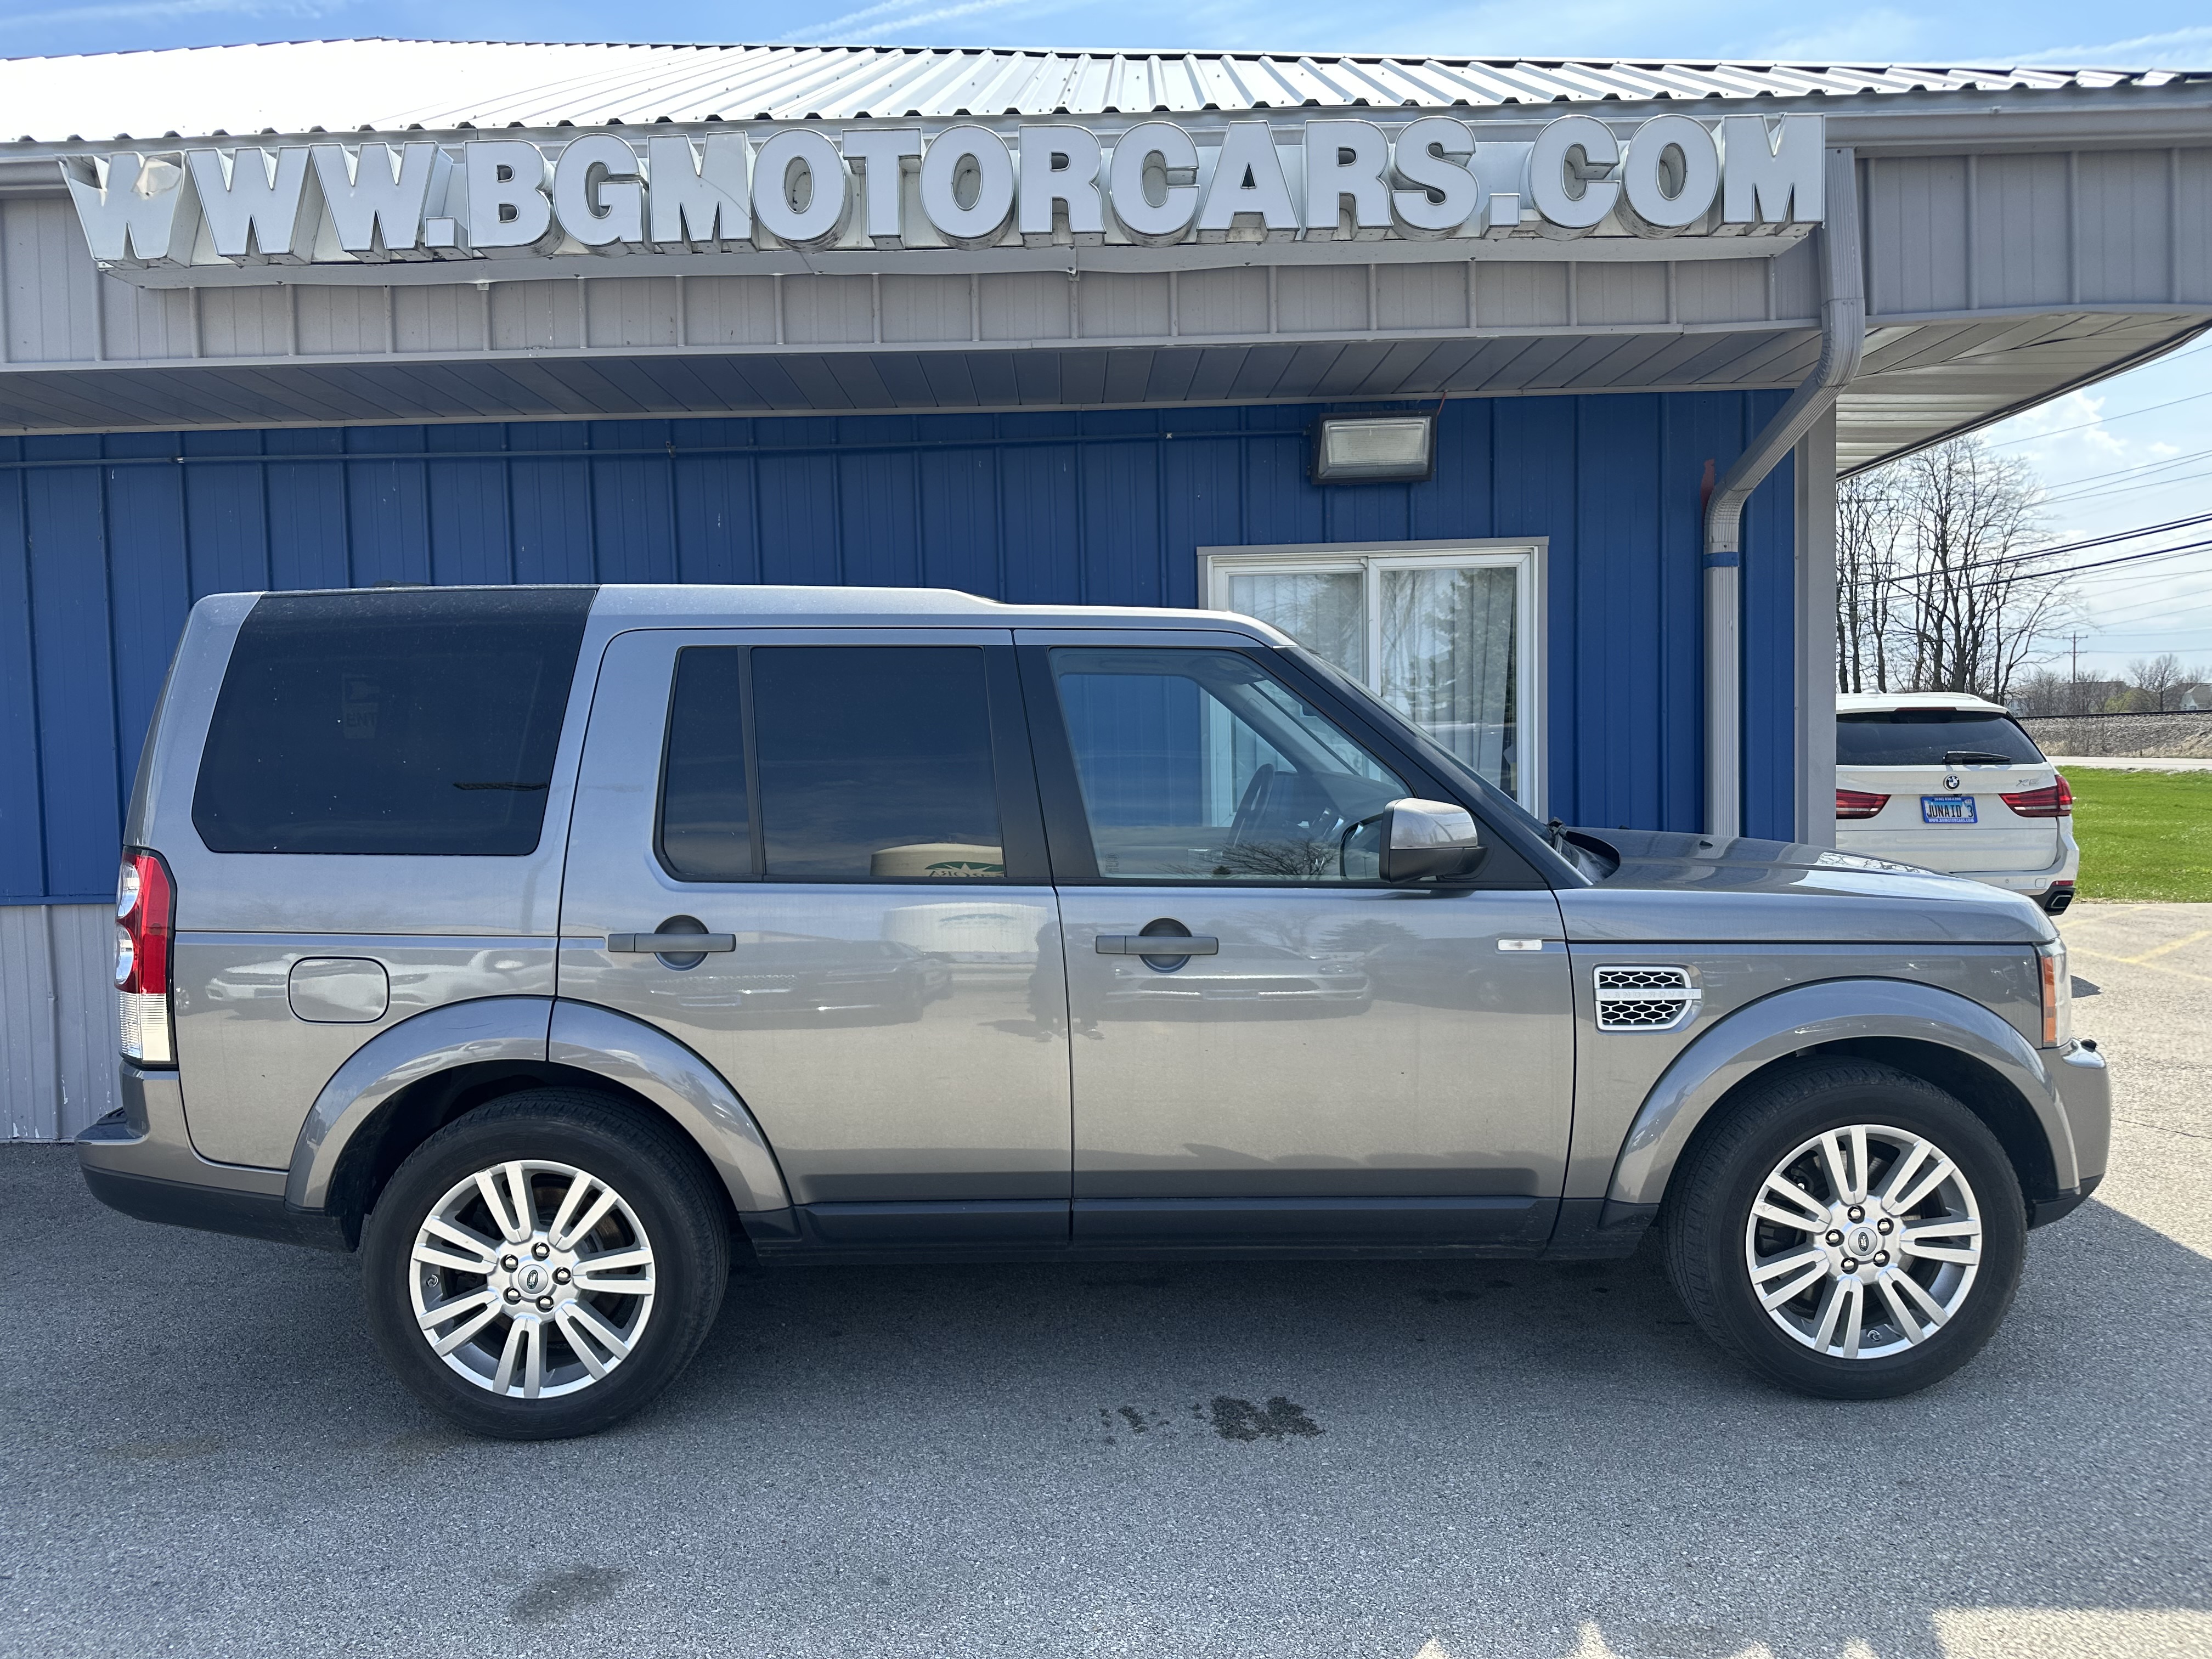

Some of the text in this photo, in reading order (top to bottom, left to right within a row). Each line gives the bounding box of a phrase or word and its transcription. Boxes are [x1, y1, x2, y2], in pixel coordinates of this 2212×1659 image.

[58, 112, 1825, 261] WWW.BGMOTORCARS.COM
[2016, 778, 2039, 787] X5
[1927, 805, 1973, 817] JUNAID 3
